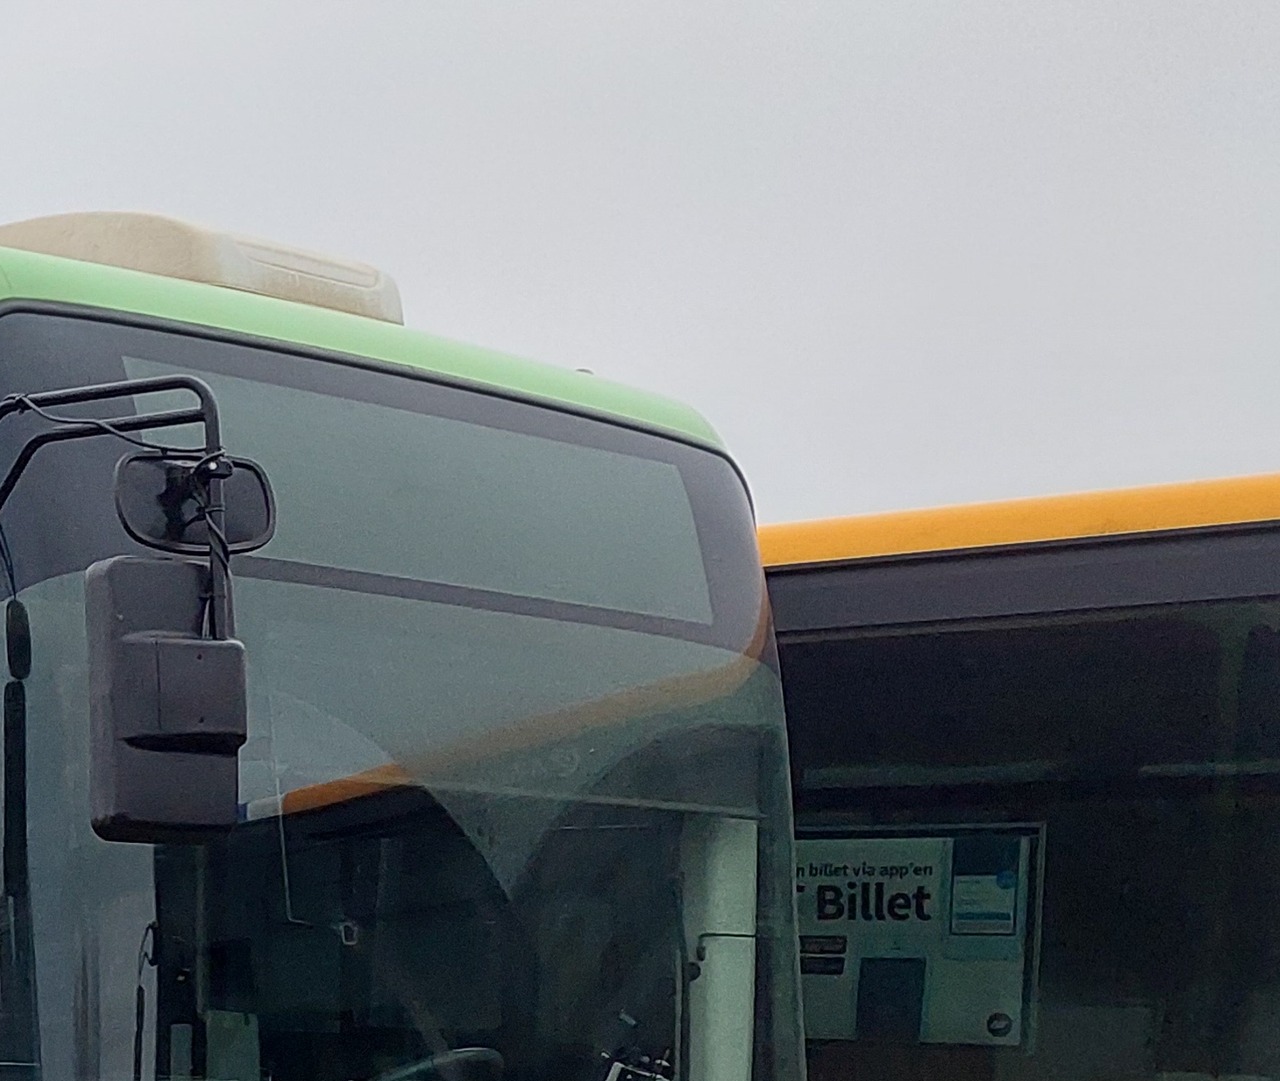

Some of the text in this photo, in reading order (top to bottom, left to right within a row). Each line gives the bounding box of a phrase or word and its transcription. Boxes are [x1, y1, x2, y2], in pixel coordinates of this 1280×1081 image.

[809, 862, 849, 878] billet
[853, 861, 875, 877] via
[879, 861, 933, 879] app'en
[817, 881, 932, 921] Billet
